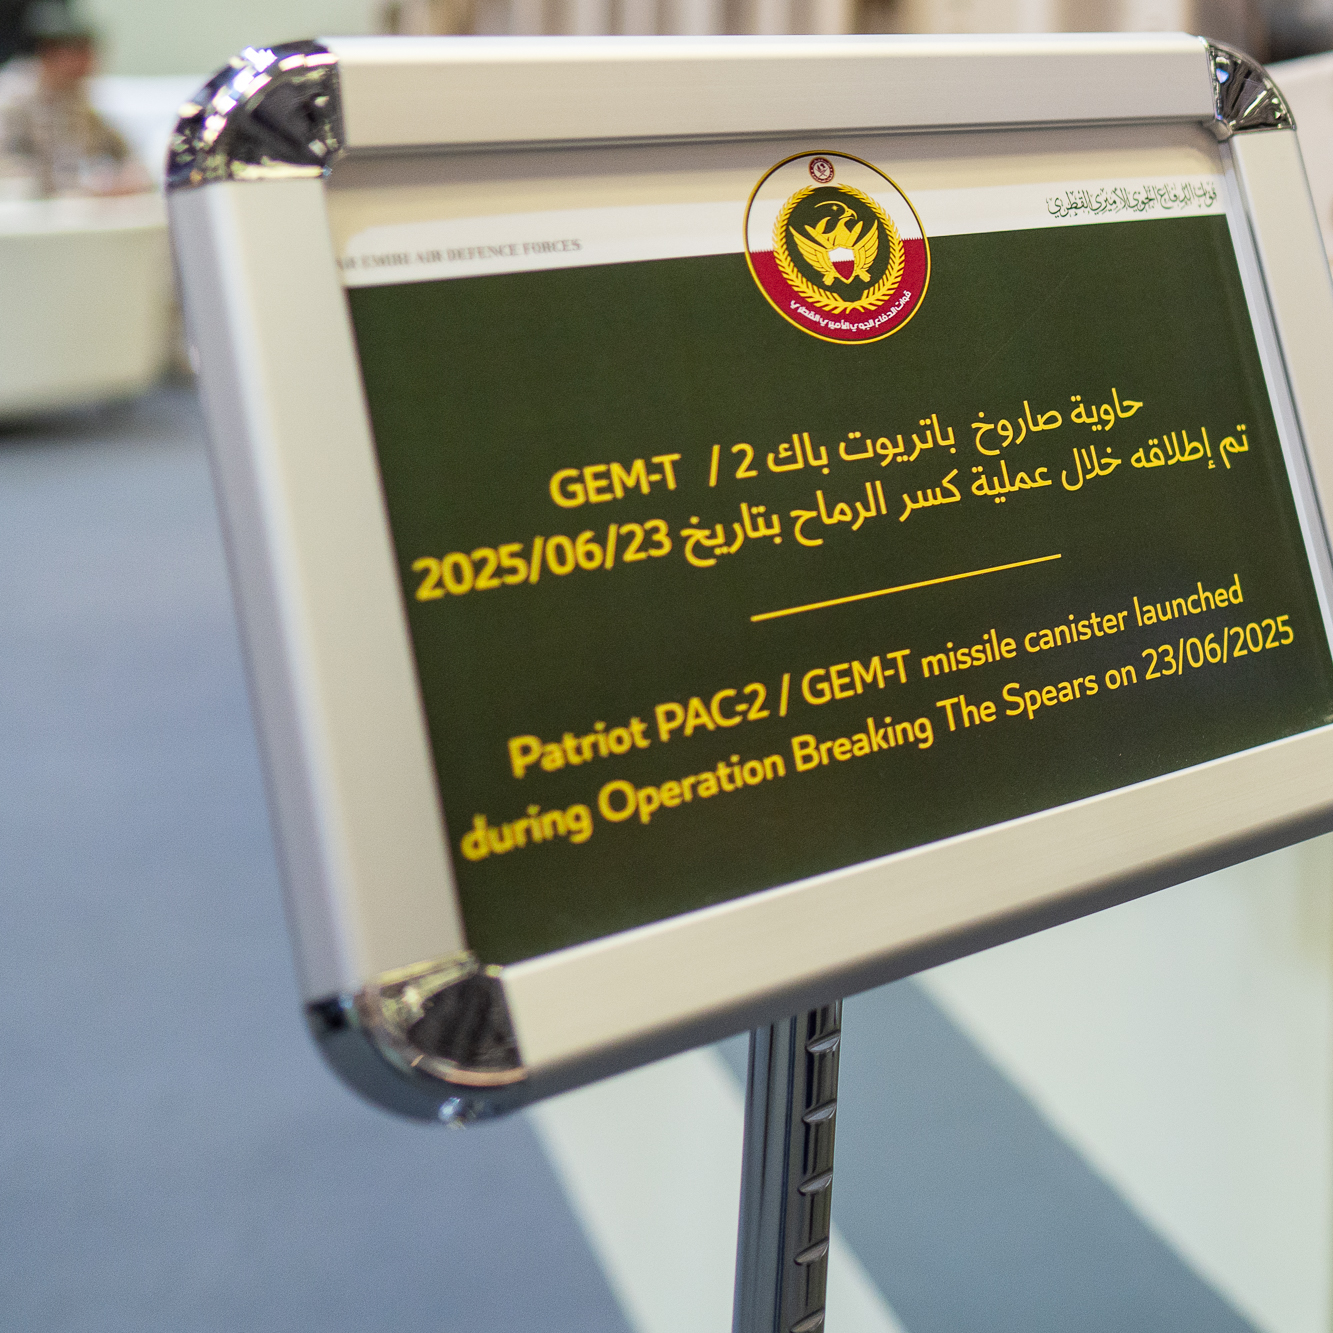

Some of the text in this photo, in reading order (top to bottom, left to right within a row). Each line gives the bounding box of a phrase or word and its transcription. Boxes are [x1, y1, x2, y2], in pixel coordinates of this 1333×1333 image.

[414, 249, 443, 264] AIR
[447, 243, 521, 261] DEFENCE
[522, 239, 583, 254] FORCES
[894, 289, 912, 311] قوات
[874, 306, 897, 328] الدفاع
[549, 387, 1144, 508] حاوية صاروخ باتريوت باك 2 / GEM-T
[412, 423, 1250, 602] تم إطلاقه خلال عملية كسر الرماح بتاريخ 2025/06/23
[507, 574, 1244, 780] Patriot PAC-2 / GEM-T missile canister launched
[460, 614, 1295, 862] during Operation Breaking The Spears on 23/06/2025
